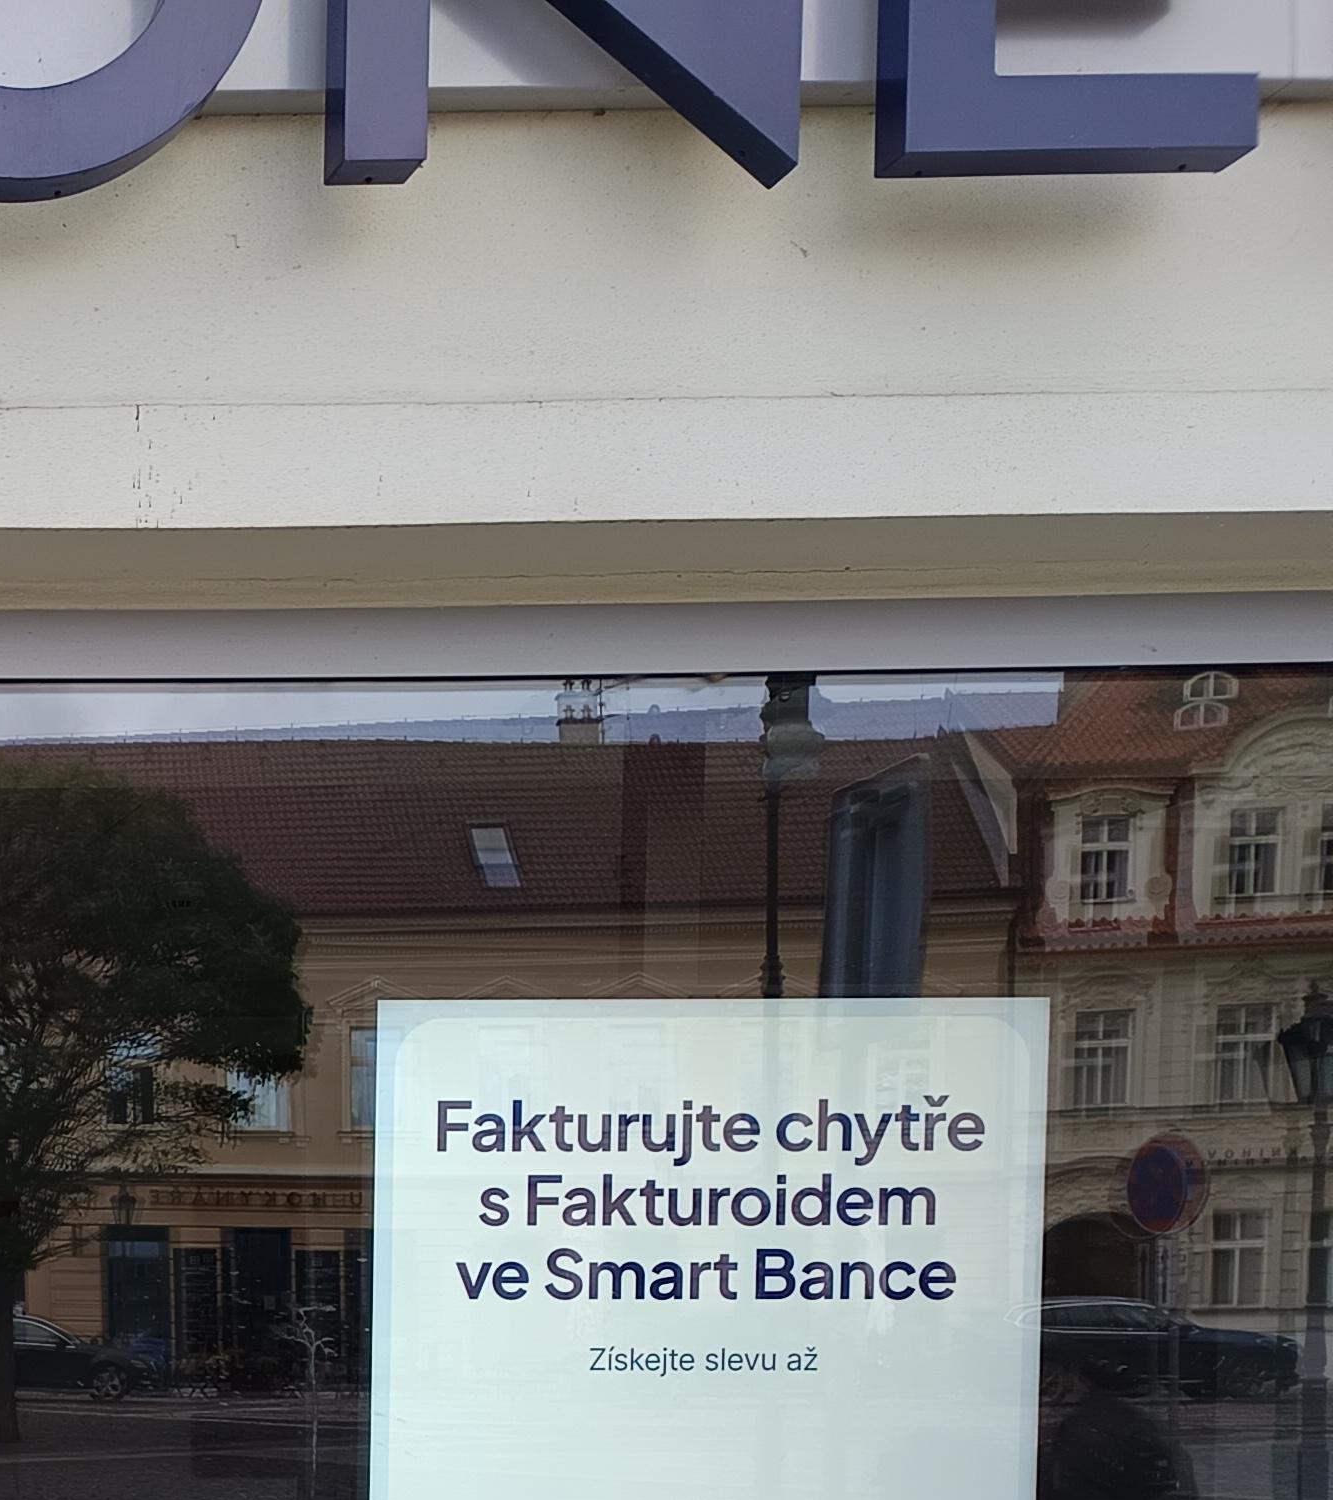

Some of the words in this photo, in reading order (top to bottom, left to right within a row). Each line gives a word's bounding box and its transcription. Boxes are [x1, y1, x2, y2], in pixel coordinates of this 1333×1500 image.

[435, 1098, 762, 1168] Fakturujte
[774, 1093, 987, 1168] chytře
[477, 1186, 511, 1228] s
[525, 1172, 937, 1228] Fakturoidem
[454, 1260, 531, 1302] ve
[543, 1246, 740, 1302] Smart
[753, 1247, 958, 1302] Bance
[588, 1344, 696, 1379] Získejte
[704, 1346, 778, 1373] slevu
[785, 1345, 819, 1373] až
